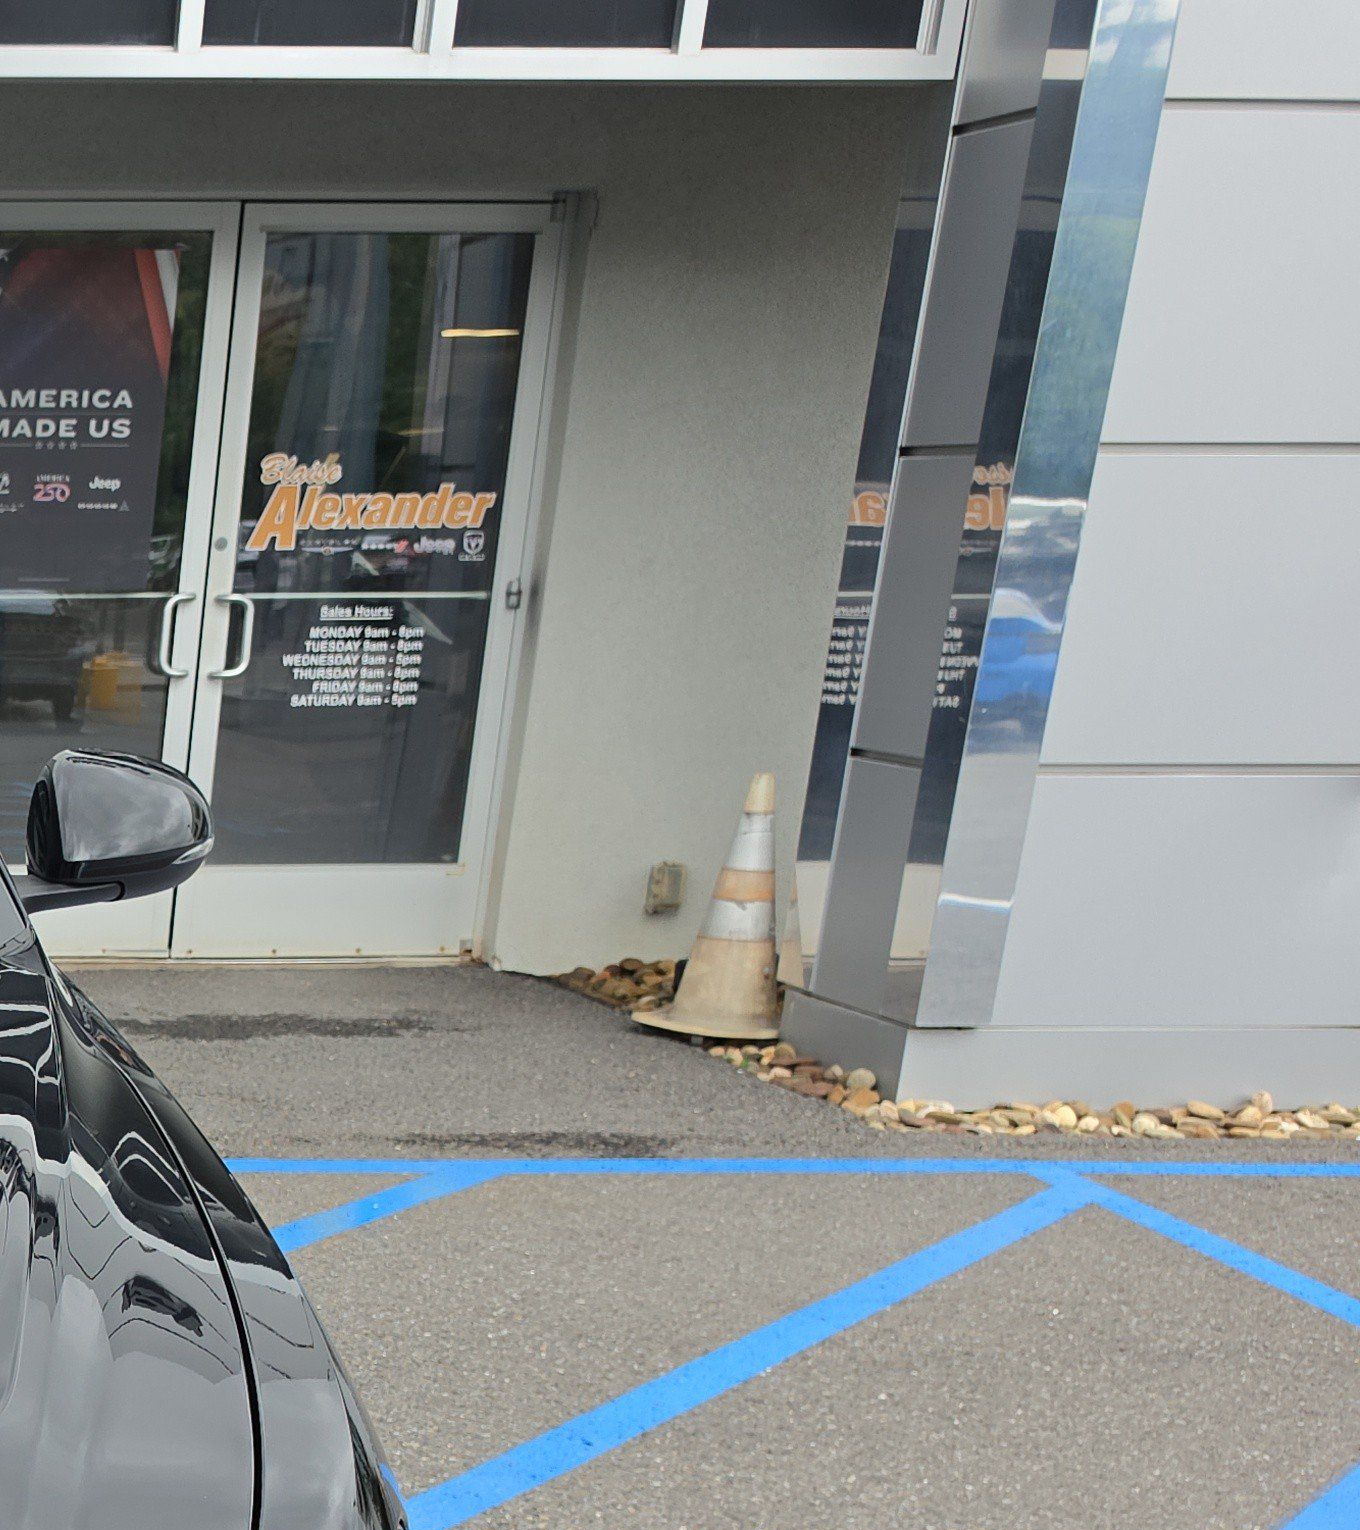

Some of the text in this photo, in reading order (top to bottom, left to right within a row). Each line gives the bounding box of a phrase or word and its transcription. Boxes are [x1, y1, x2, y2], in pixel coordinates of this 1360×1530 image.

[88, 418, 131, 438] US
[260, 452, 343, 486] Blaise
[88, 475, 121, 492] Jeep
[245, 482, 497, 551] Alexander
[320, 605, 352, 618] Sales
[309, 626, 363, 639] MONDAY
[304, 640, 362, 652] TUESDAY
[282, 654, 361, 666] WEDNESDAY
[292, 667, 358, 680] THURSDAY
[312, 681, 358, 693] FRIDAY
[290, 694, 355, 707] SATURDAY
